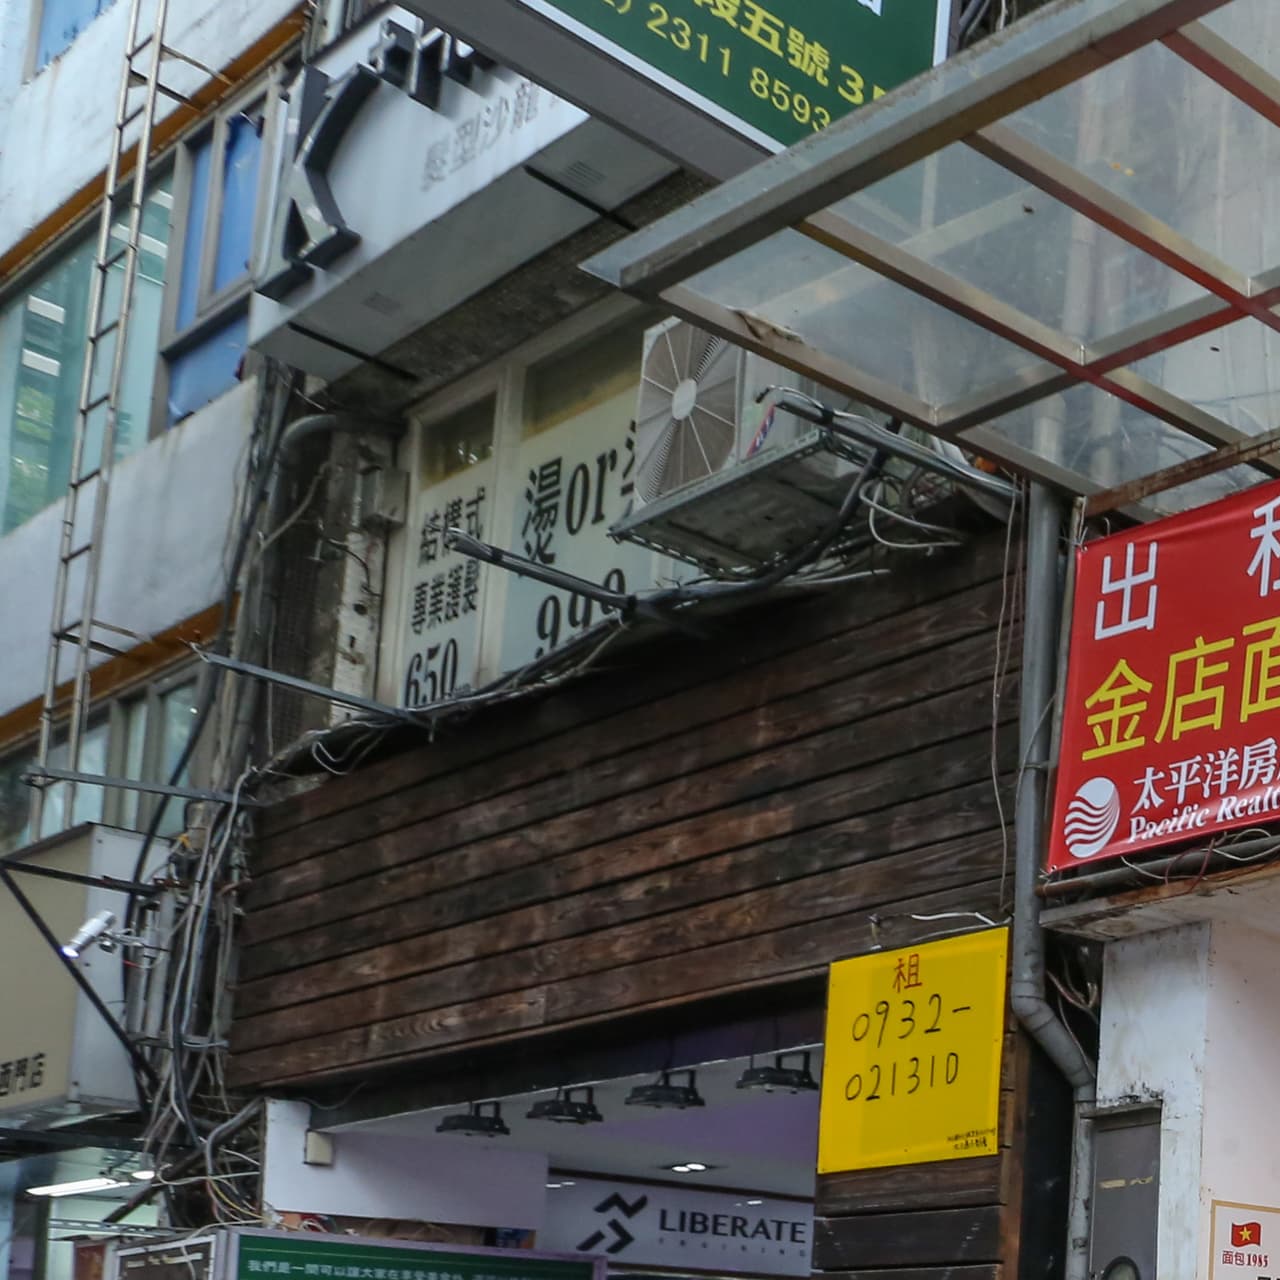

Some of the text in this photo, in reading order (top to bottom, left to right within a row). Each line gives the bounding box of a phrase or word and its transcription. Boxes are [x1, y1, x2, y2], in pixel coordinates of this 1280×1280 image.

[645, 5, 731, 77] 2311
[1128, 808, 1210, 845] Pacific
[852, 993, 971, 1049] 0932-
[845, 1052, 959, 1101] 021310
[659, 1208, 806, 1244] LIBERATE
